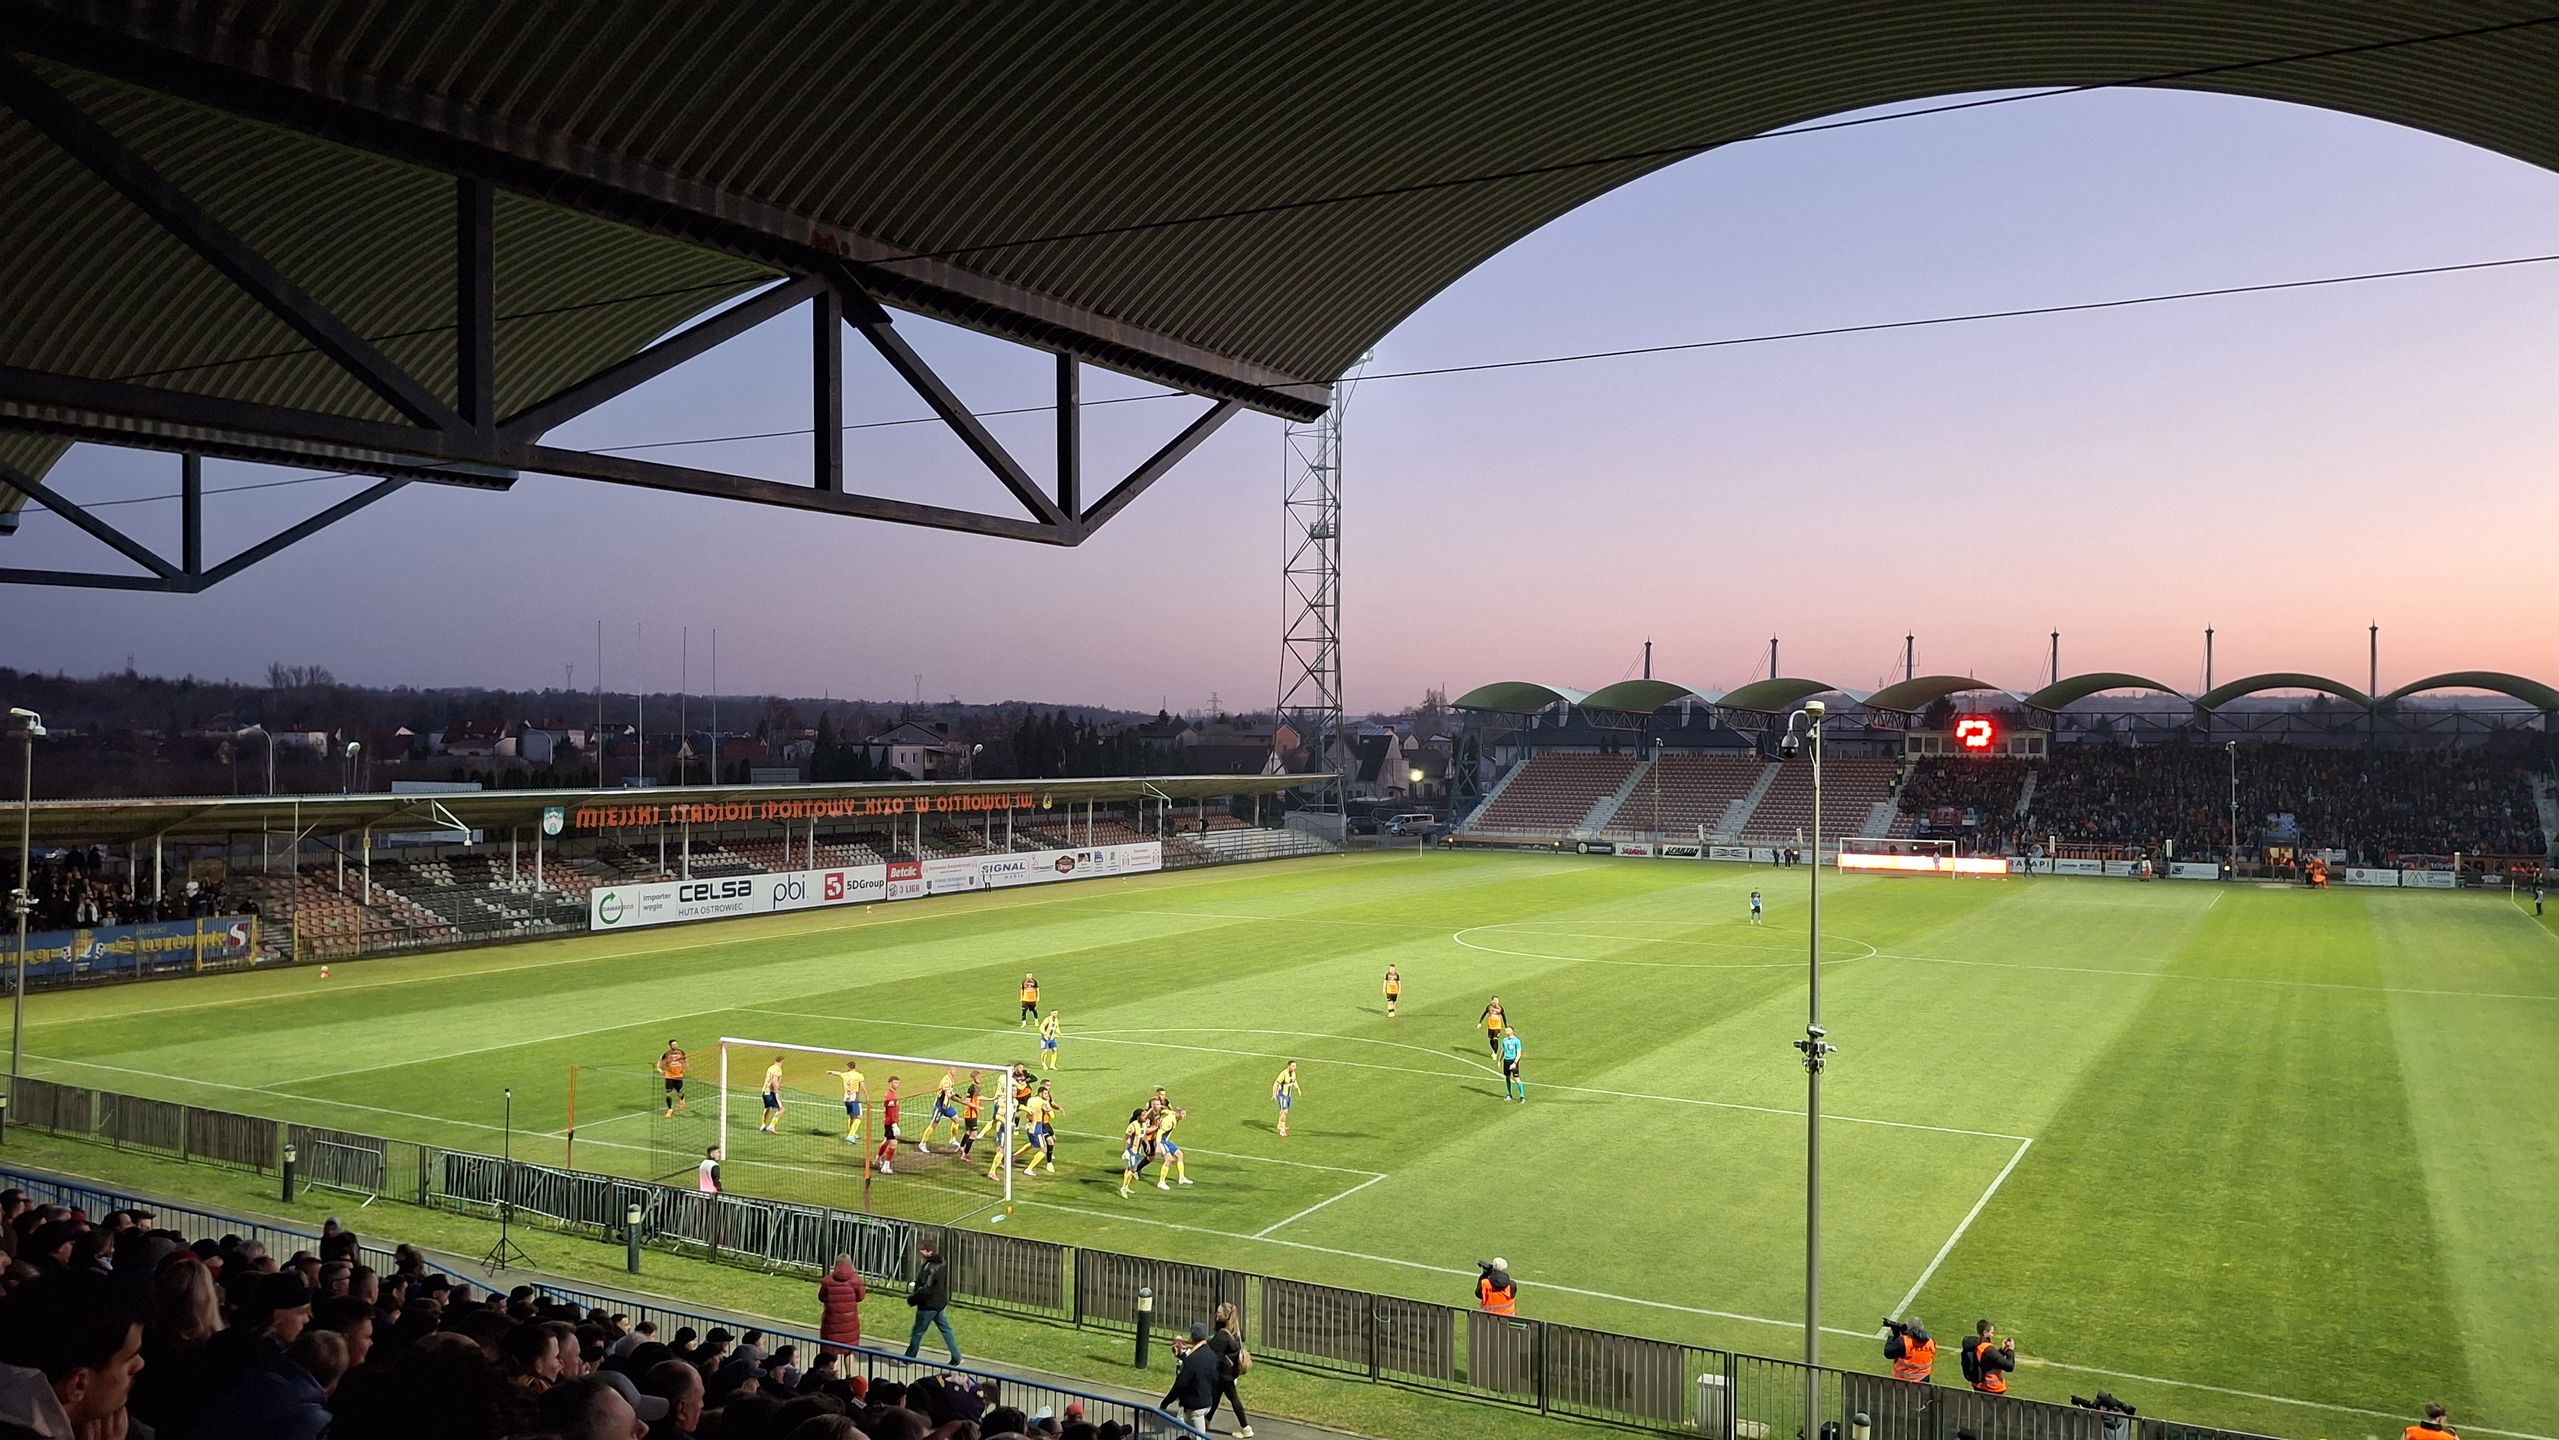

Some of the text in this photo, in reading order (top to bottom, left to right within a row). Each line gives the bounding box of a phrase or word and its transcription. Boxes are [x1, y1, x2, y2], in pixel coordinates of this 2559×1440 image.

[576, 805, 660, 829] MIEJSKI
[670, 802, 753, 824] STADION
[761, 799, 855, 819] SPORTOWY
[914, 796, 930, 814] W
[936, 793, 1011, 813] OSTROWCU
[1667, 846, 1700, 854] SPARTAN
[981, 861, 1026, 874] SIGNAL
[2008, 859, 2049, 868] RAAPI
[890, 865, 917, 878] Betclic
[847, 879, 885, 891] 5DGroup
[905, 884, 920, 893] LIGA
[643, 893, 672, 902] Importer
[773, 874, 805, 910] pbi
[678, 902, 744, 917] HUTA OSTROWIEC
